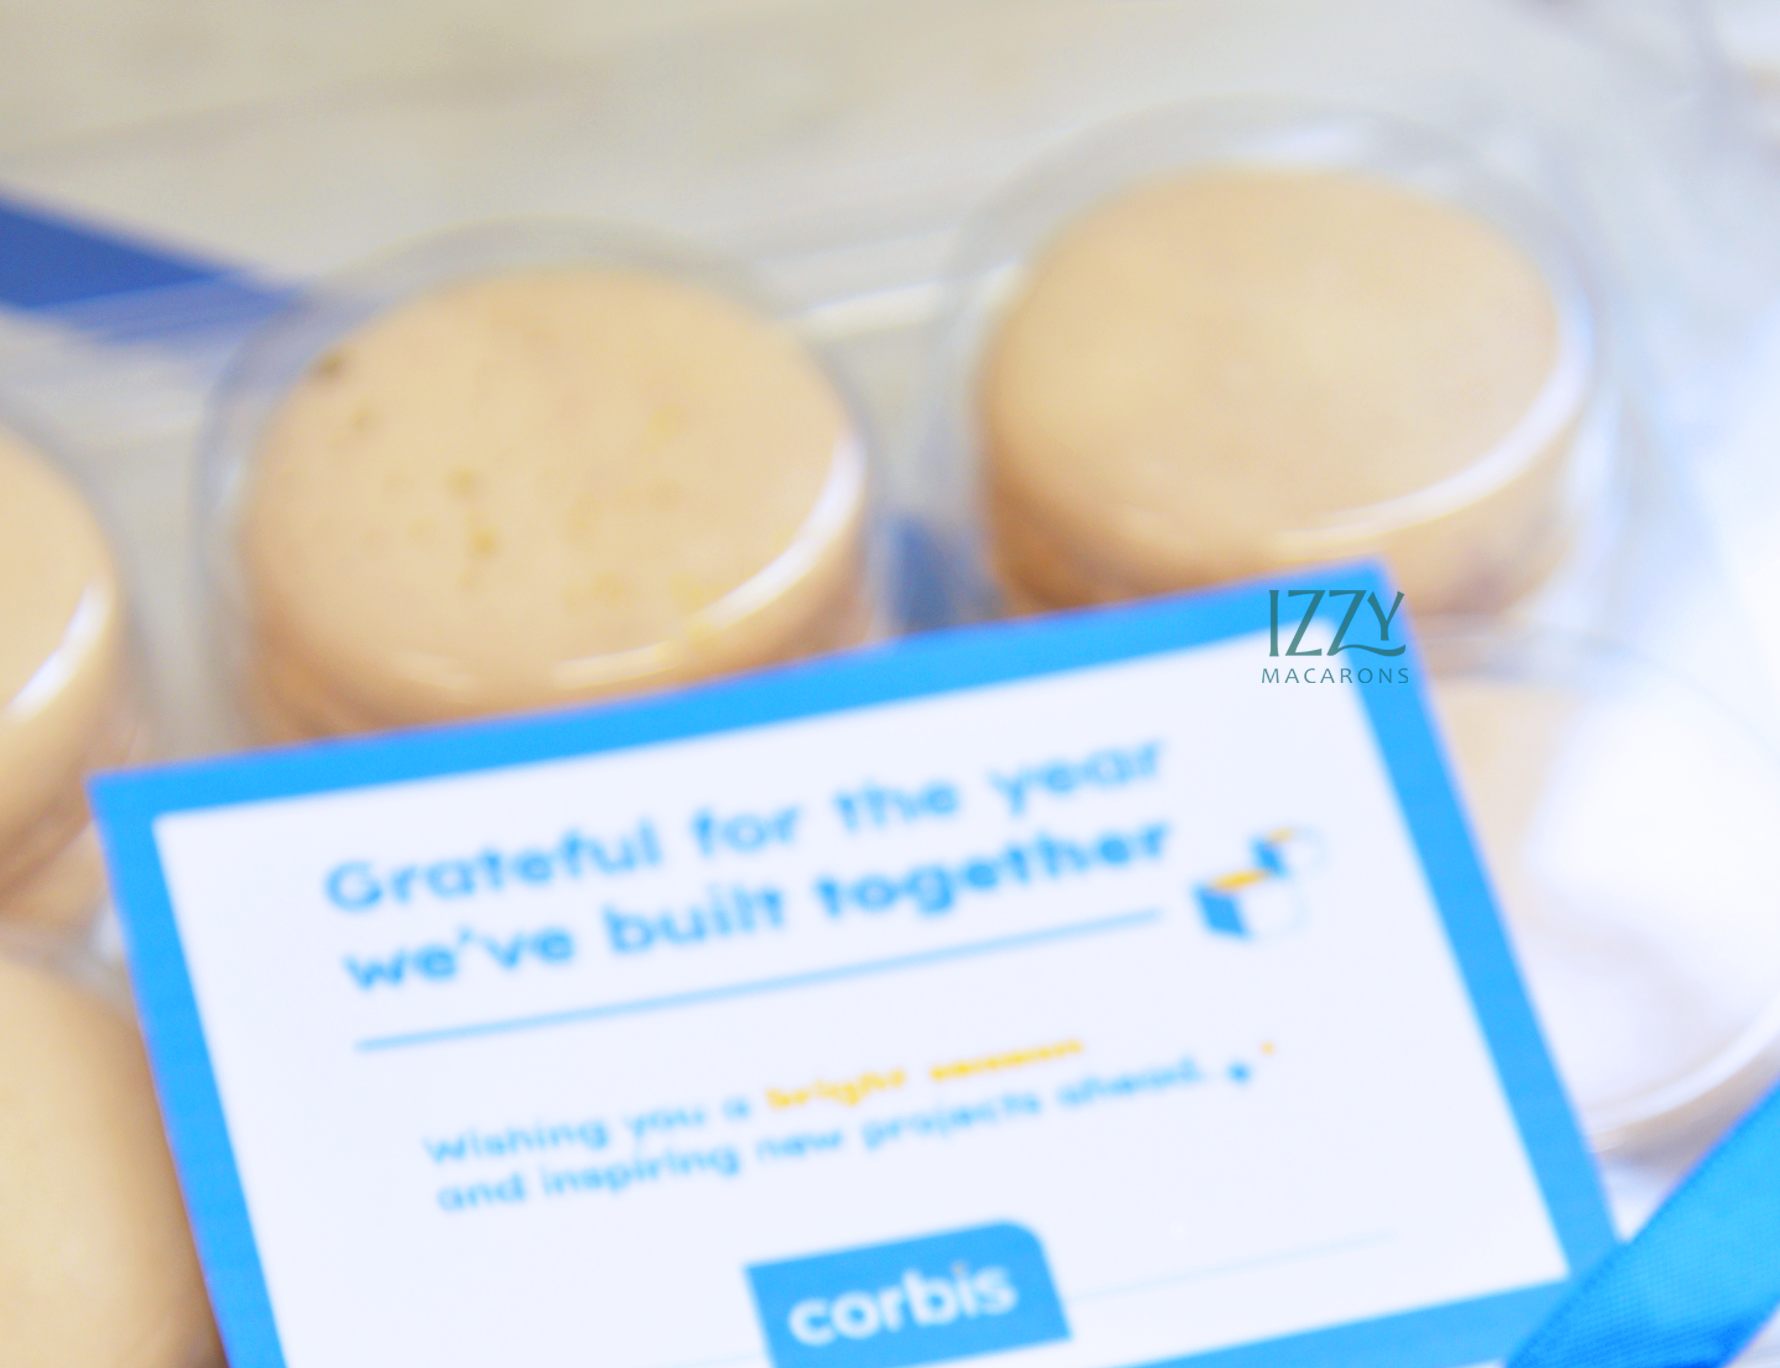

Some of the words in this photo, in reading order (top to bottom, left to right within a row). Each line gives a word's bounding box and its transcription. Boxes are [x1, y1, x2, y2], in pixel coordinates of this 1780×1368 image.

[324, 817, 664, 912] Grateful
[689, 805, 801, 858] for
[832, 779, 961, 832] the
[988, 740, 1164, 817] year
[343, 926, 577, 992] we've
[601, 881, 787, 955] built
[813, 821, 1170, 915] together
[423, 1116, 609, 1165] Wishing
[623, 1106, 708, 1140] you
[722, 1096, 752, 1122] a
[436, 1172, 527, 1212] and
[541, 1146, 742, 1195] inspiring
[756, 1128, 844, 1161] new
[861, 1091, 1043, 1151] projects
[788, 1260, 1019, 1346] corbis
